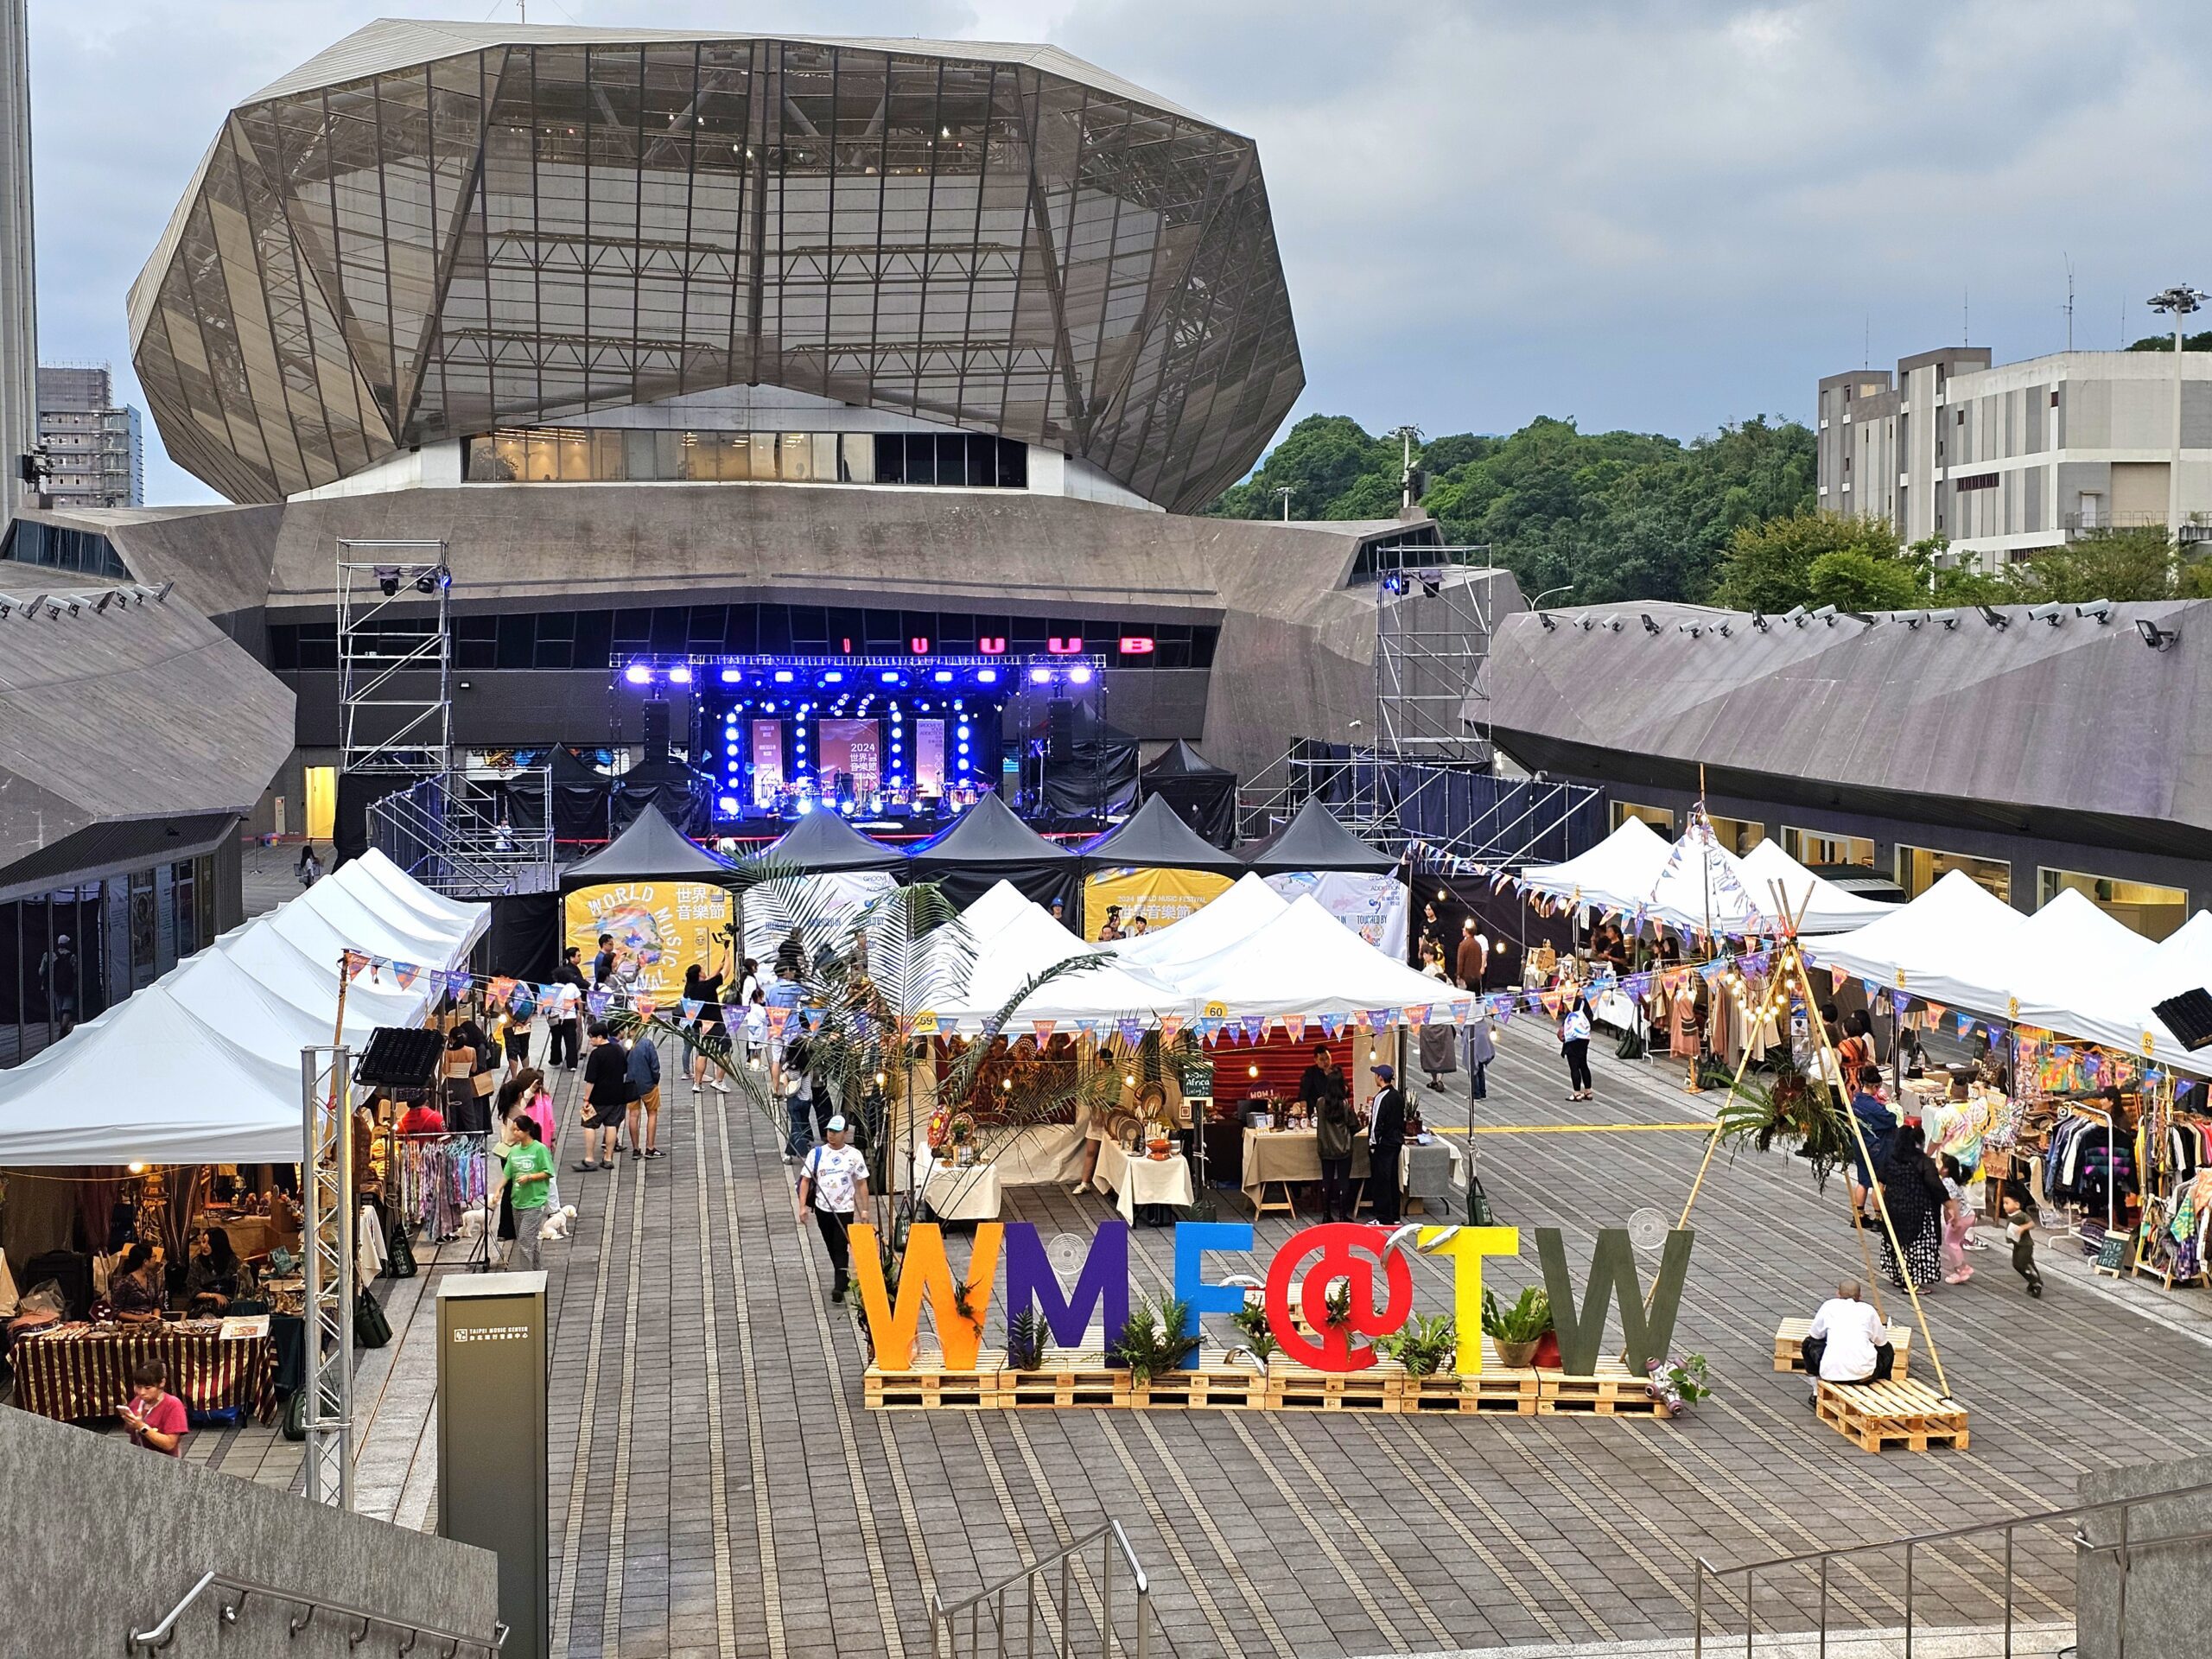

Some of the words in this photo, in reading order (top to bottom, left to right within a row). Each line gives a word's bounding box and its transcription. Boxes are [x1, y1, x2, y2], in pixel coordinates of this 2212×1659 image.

[851, 743, 875, 753] 2024
[850, 753, 868, 763] 世界
[588, 884, 654, 916] WORLD
[676, 887, 707, 903] 世界
[676, 904, 725, 920] 音樂節
[654, 906, 682, 968] MUSIC
[1210, 1007, 1223, 1017] 60
[919, 1016, 932, 1026] 59
[2145, 1039, 2152, 1048] 52
[1186, 1087, 1201, 1096] Living
